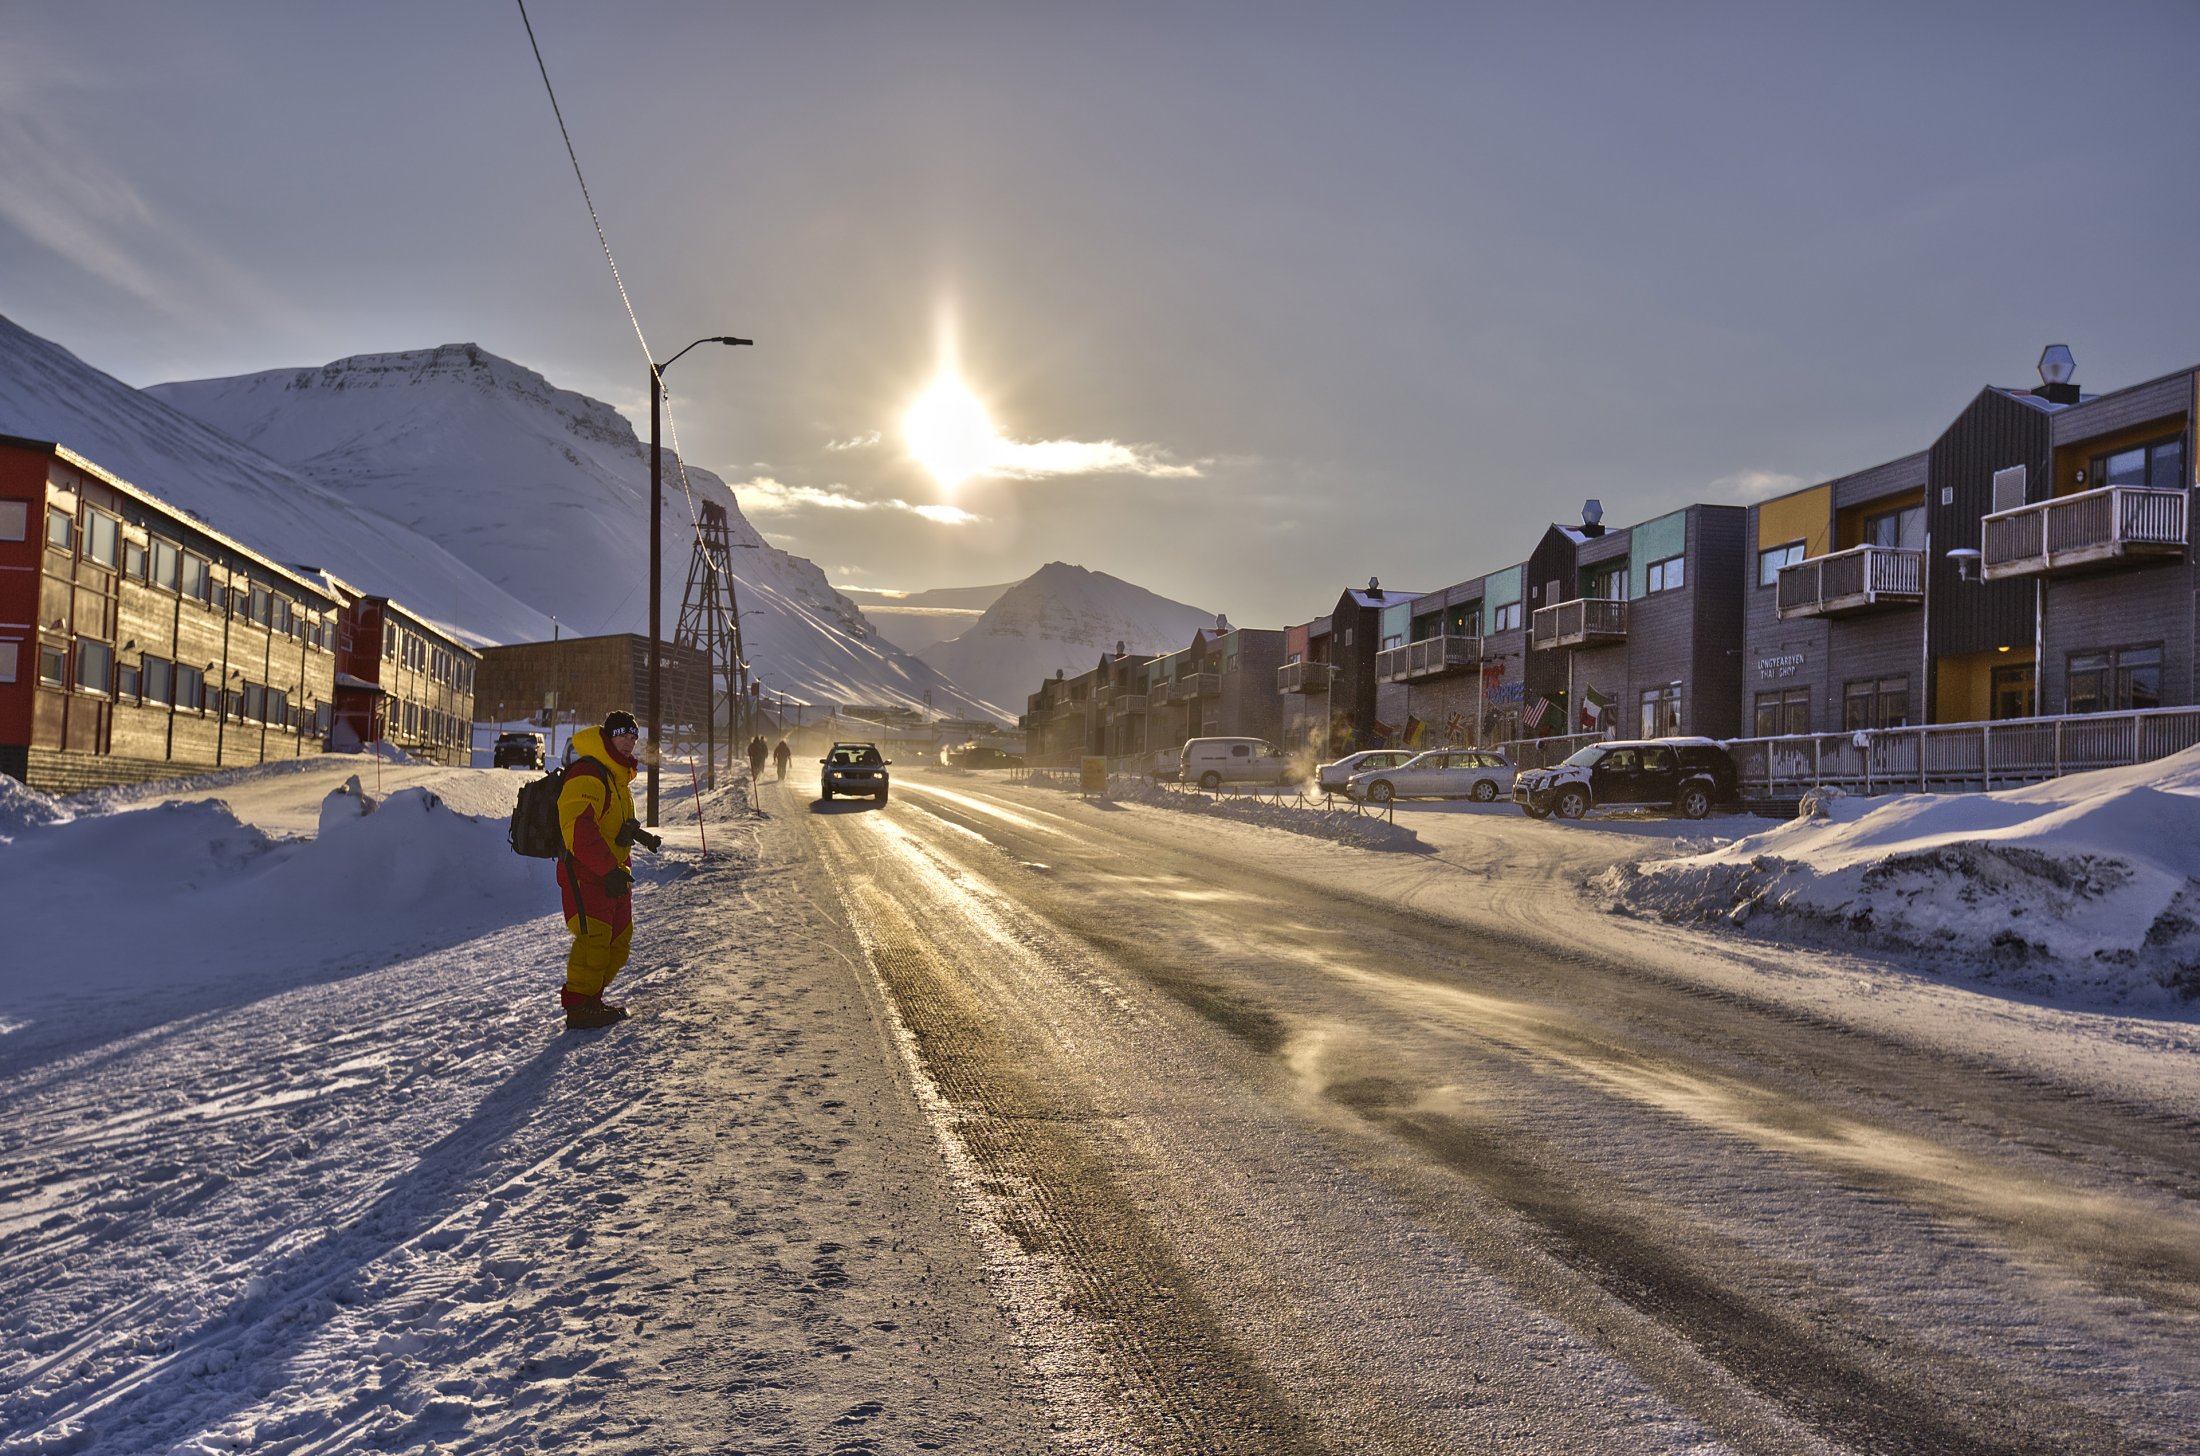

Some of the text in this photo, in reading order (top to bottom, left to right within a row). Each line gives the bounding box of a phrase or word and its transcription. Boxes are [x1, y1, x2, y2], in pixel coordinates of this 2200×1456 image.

[1758, 654, 1804, 669] LONGYEARBYEN
[1761, 666, 1796, 680] THAI SHOP
